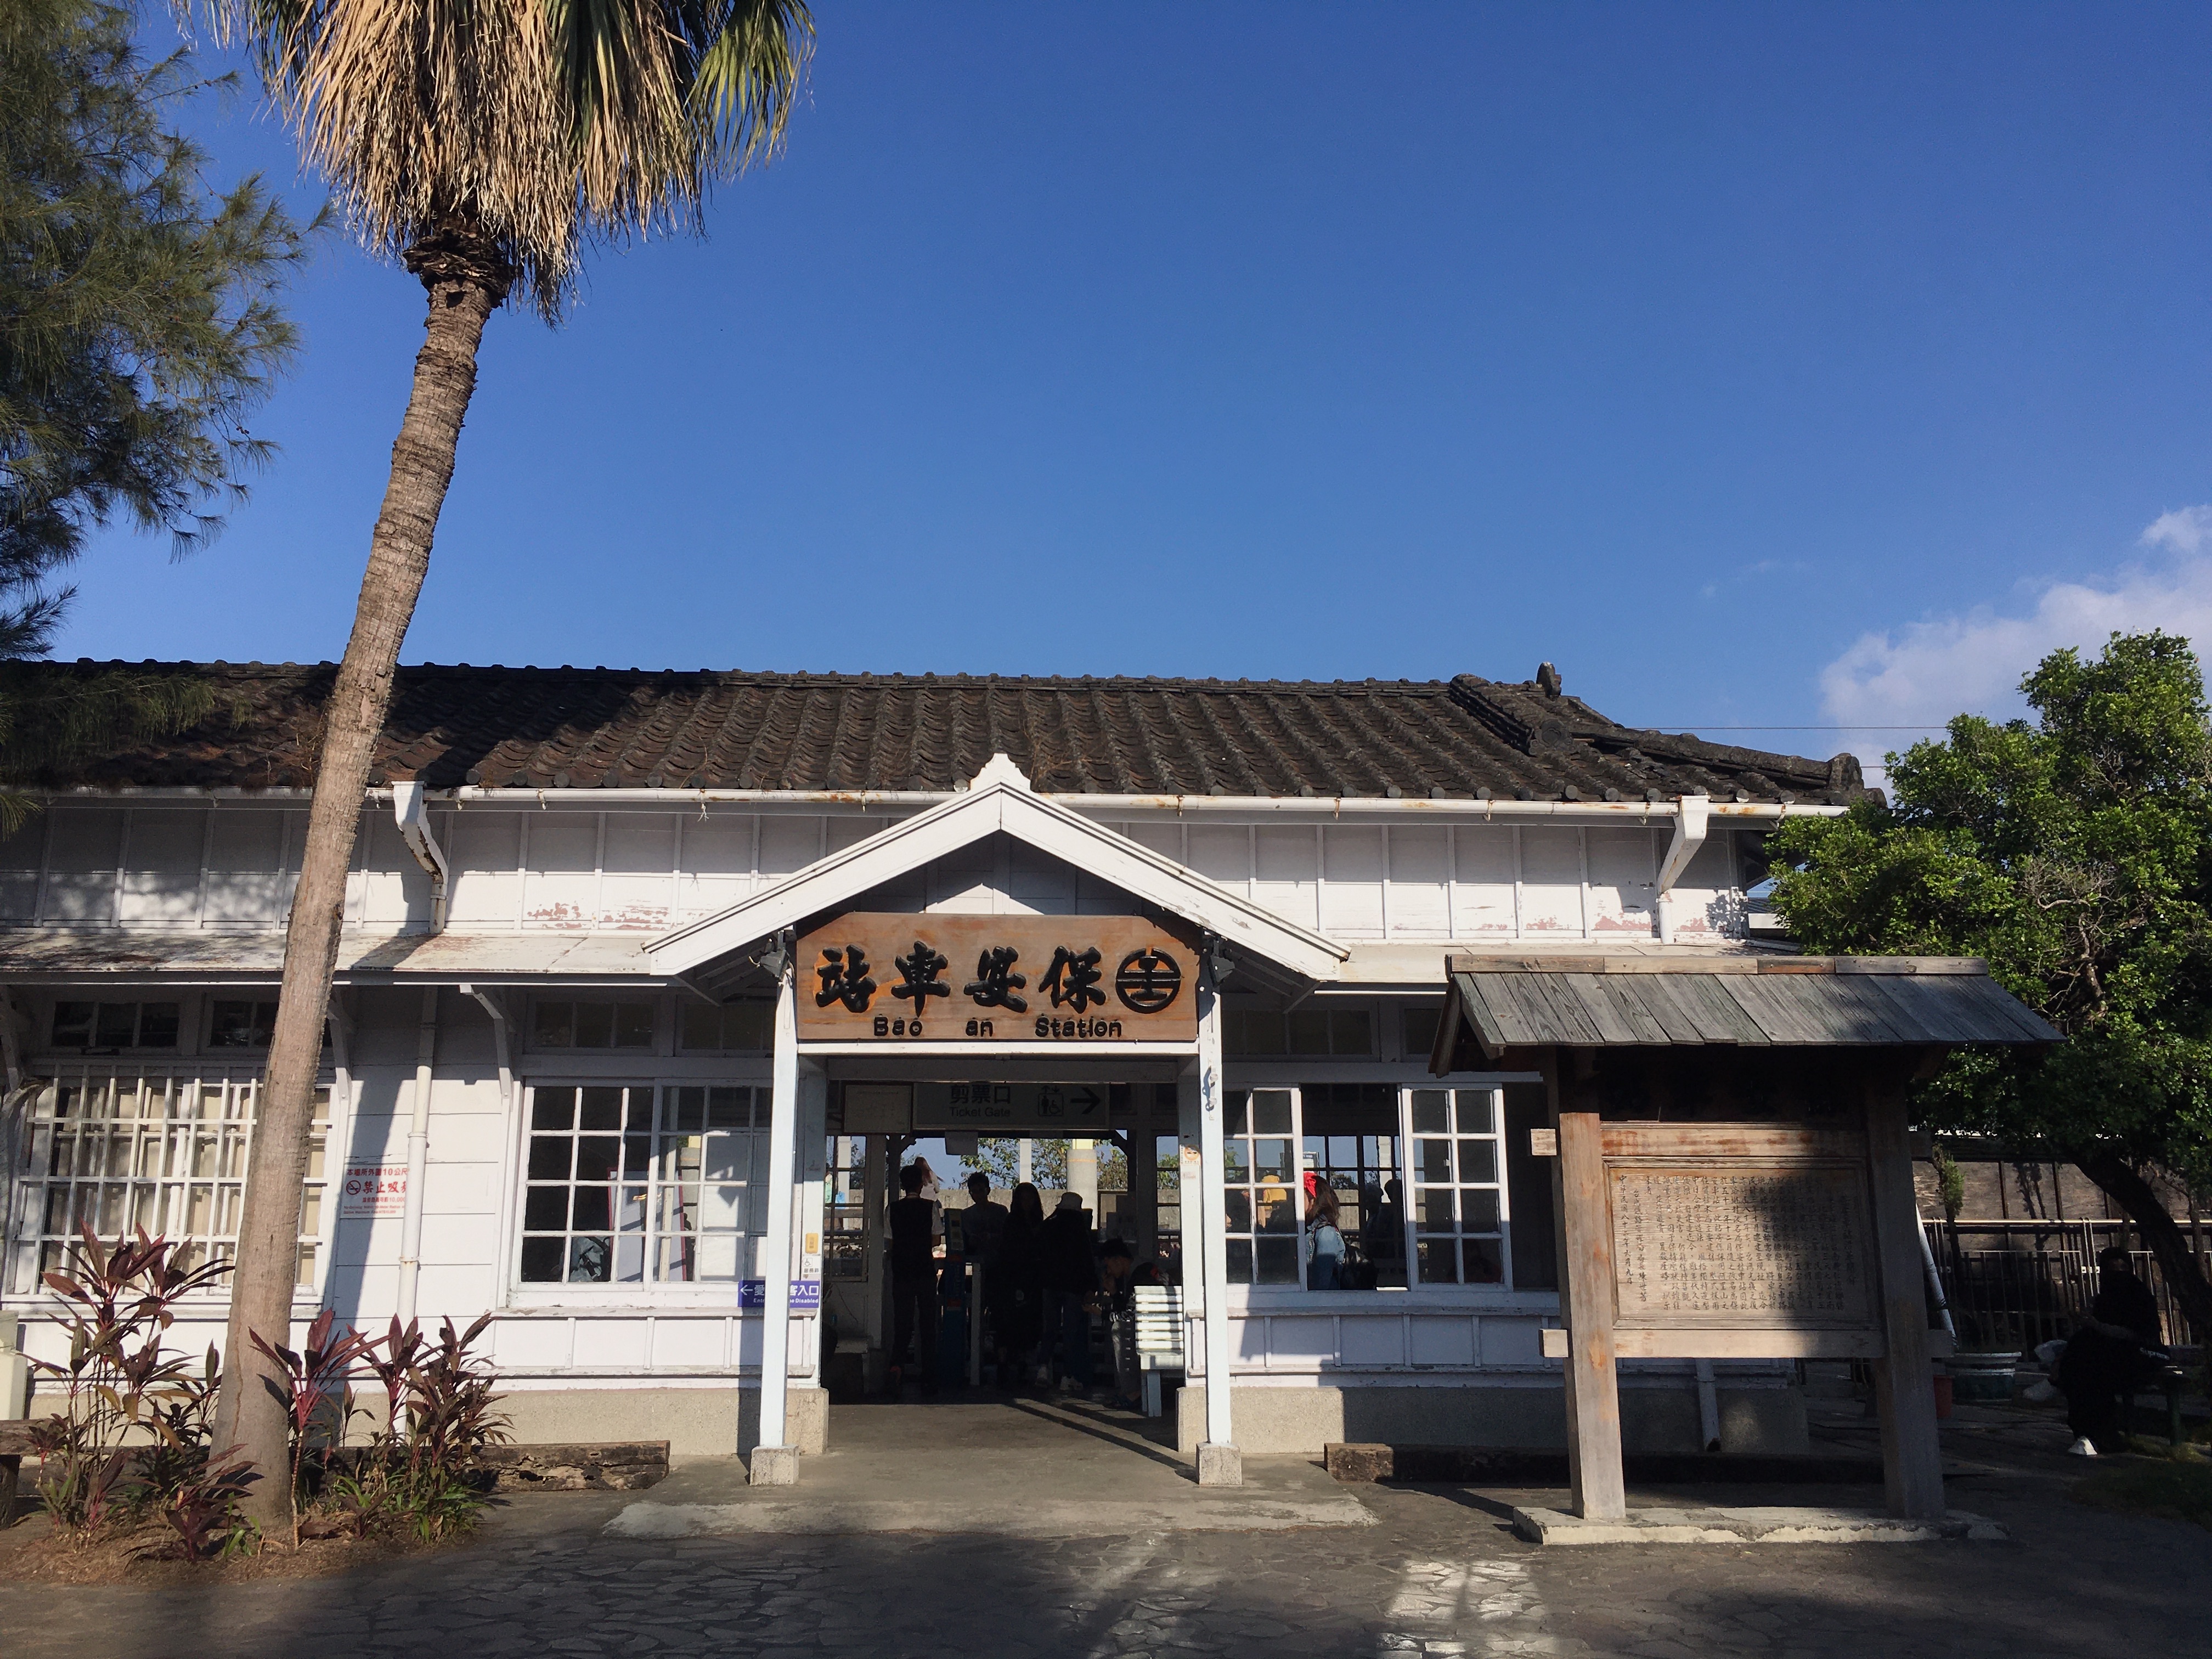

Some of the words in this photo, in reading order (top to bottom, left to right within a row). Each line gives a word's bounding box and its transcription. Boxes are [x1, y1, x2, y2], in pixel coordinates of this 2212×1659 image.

[873, 1016, 923, 1036] Bao
[965, 1018, 994, 1037] an
[1035, 1015, 1122, 1038] Station
[950, 1084, 1011, 1105] 剪票口
[950, 1107, 981, 1118] Ticket
[985, 1107, 1011, 1118] Gate
